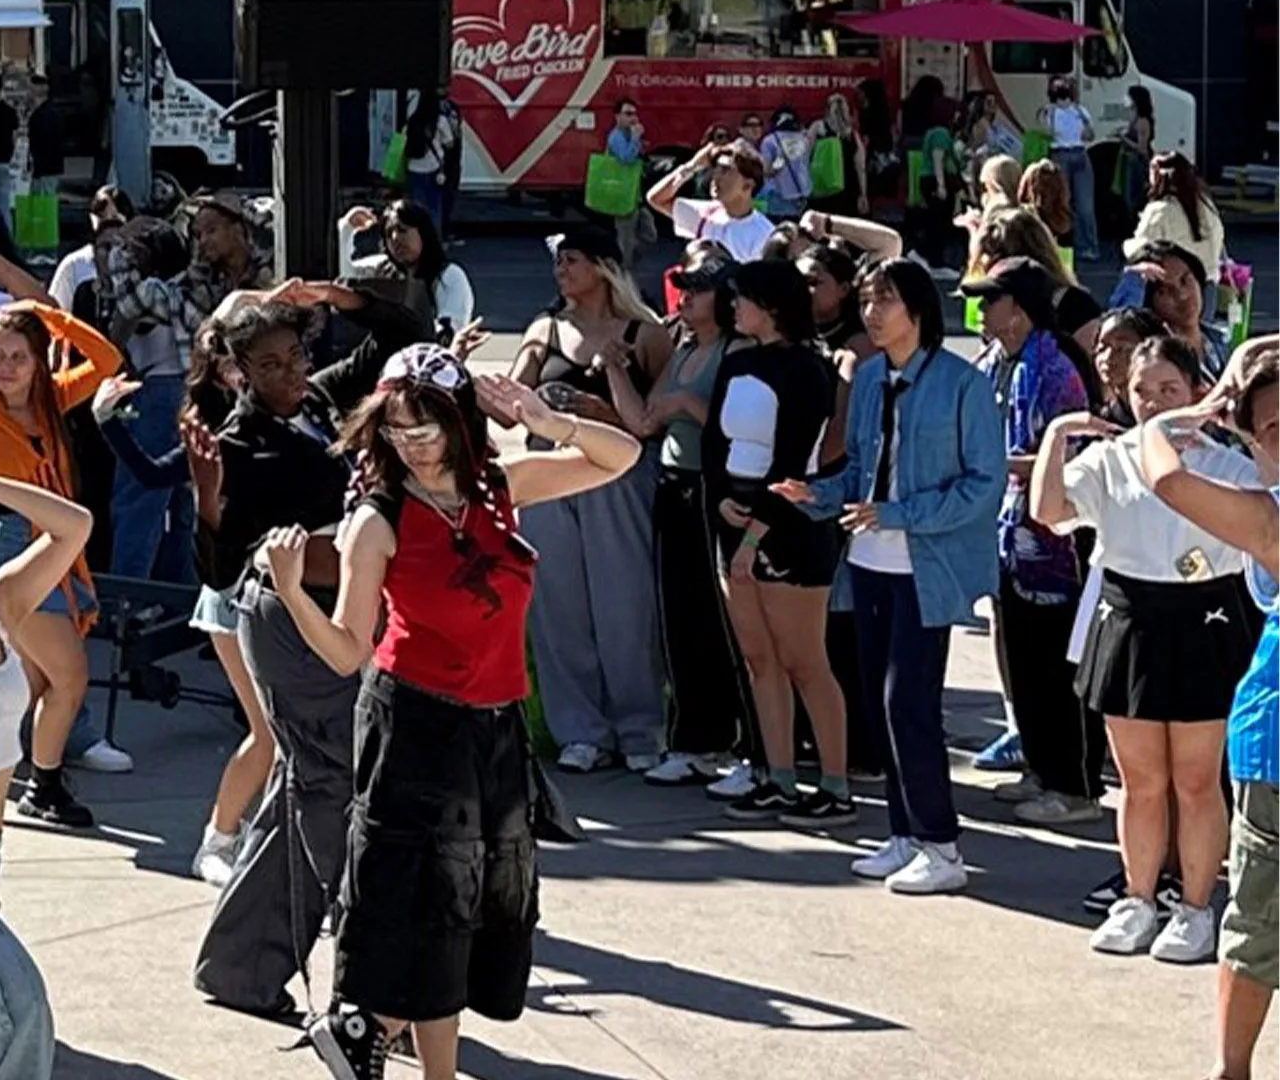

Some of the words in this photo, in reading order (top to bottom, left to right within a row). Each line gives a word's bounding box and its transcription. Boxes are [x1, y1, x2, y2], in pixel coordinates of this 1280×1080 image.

[510, 23, 596, 62] Bird
[495, 63, 530, 81] FRIED
[532, 59, 587, 77] CHICKEN
[640, 75, 702, 88] ORIGINAL
[705, 74, 752, 88] FRIED
[756, 74, 829, 88] CHICKEN
